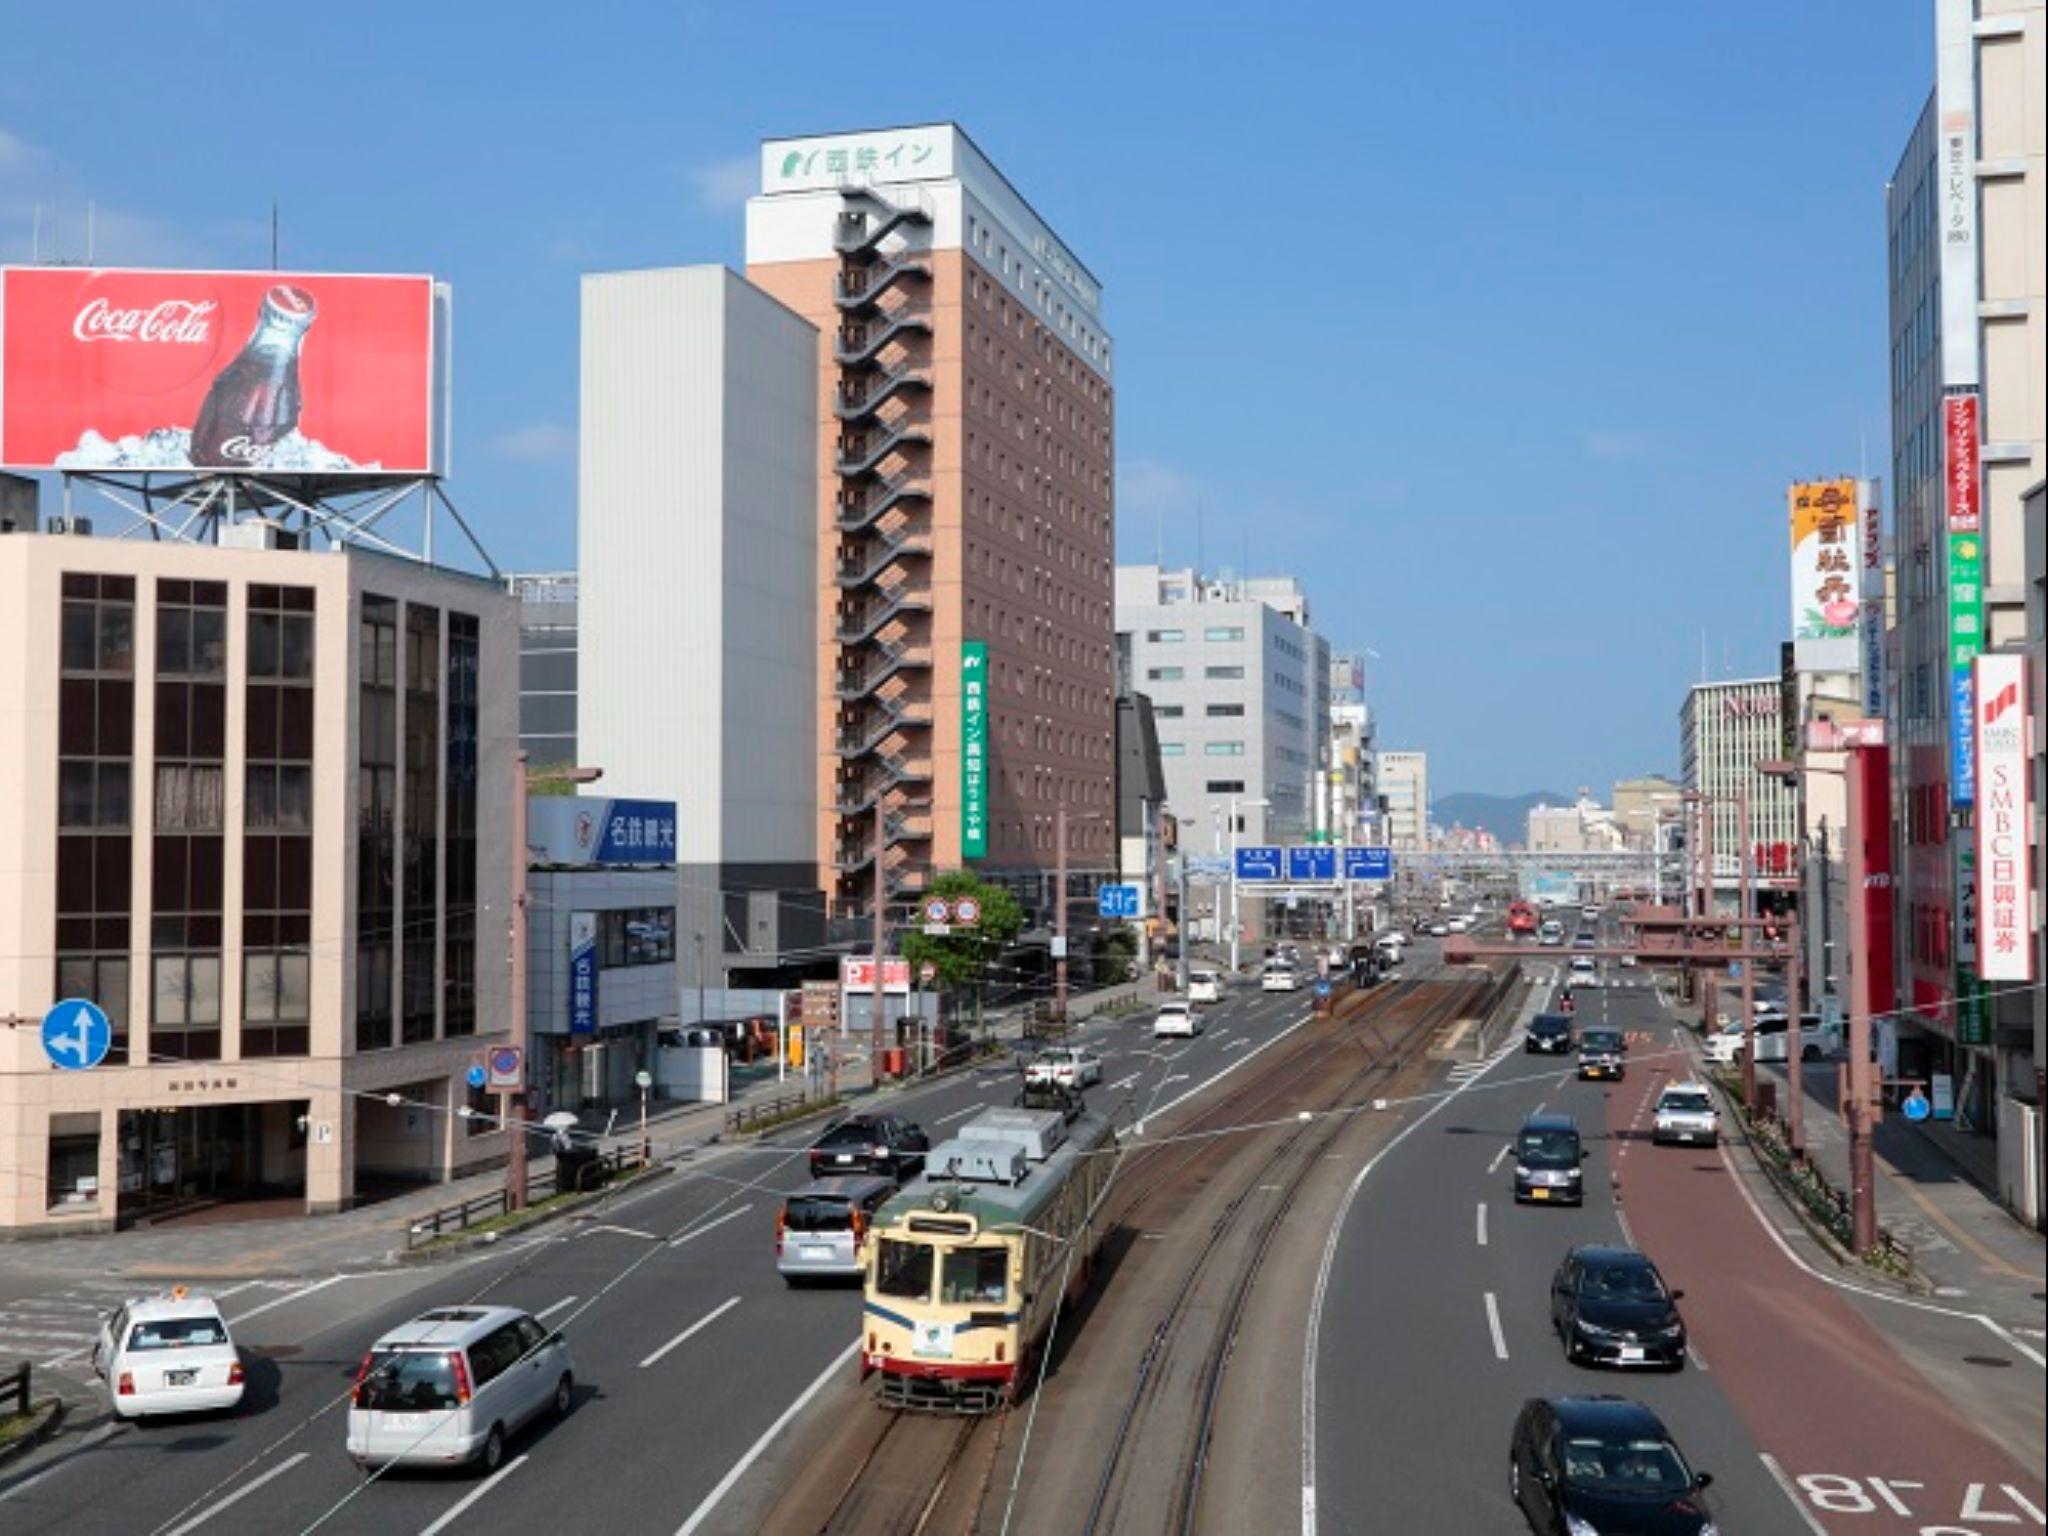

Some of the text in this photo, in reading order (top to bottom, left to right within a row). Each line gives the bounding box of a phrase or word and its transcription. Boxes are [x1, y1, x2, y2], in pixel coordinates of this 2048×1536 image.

[827, 144, 933, 173] 西鉄イン
[73, 297, 218, 343] Coca-Cola
[611, 816, 673, 846] 名鉄観光
